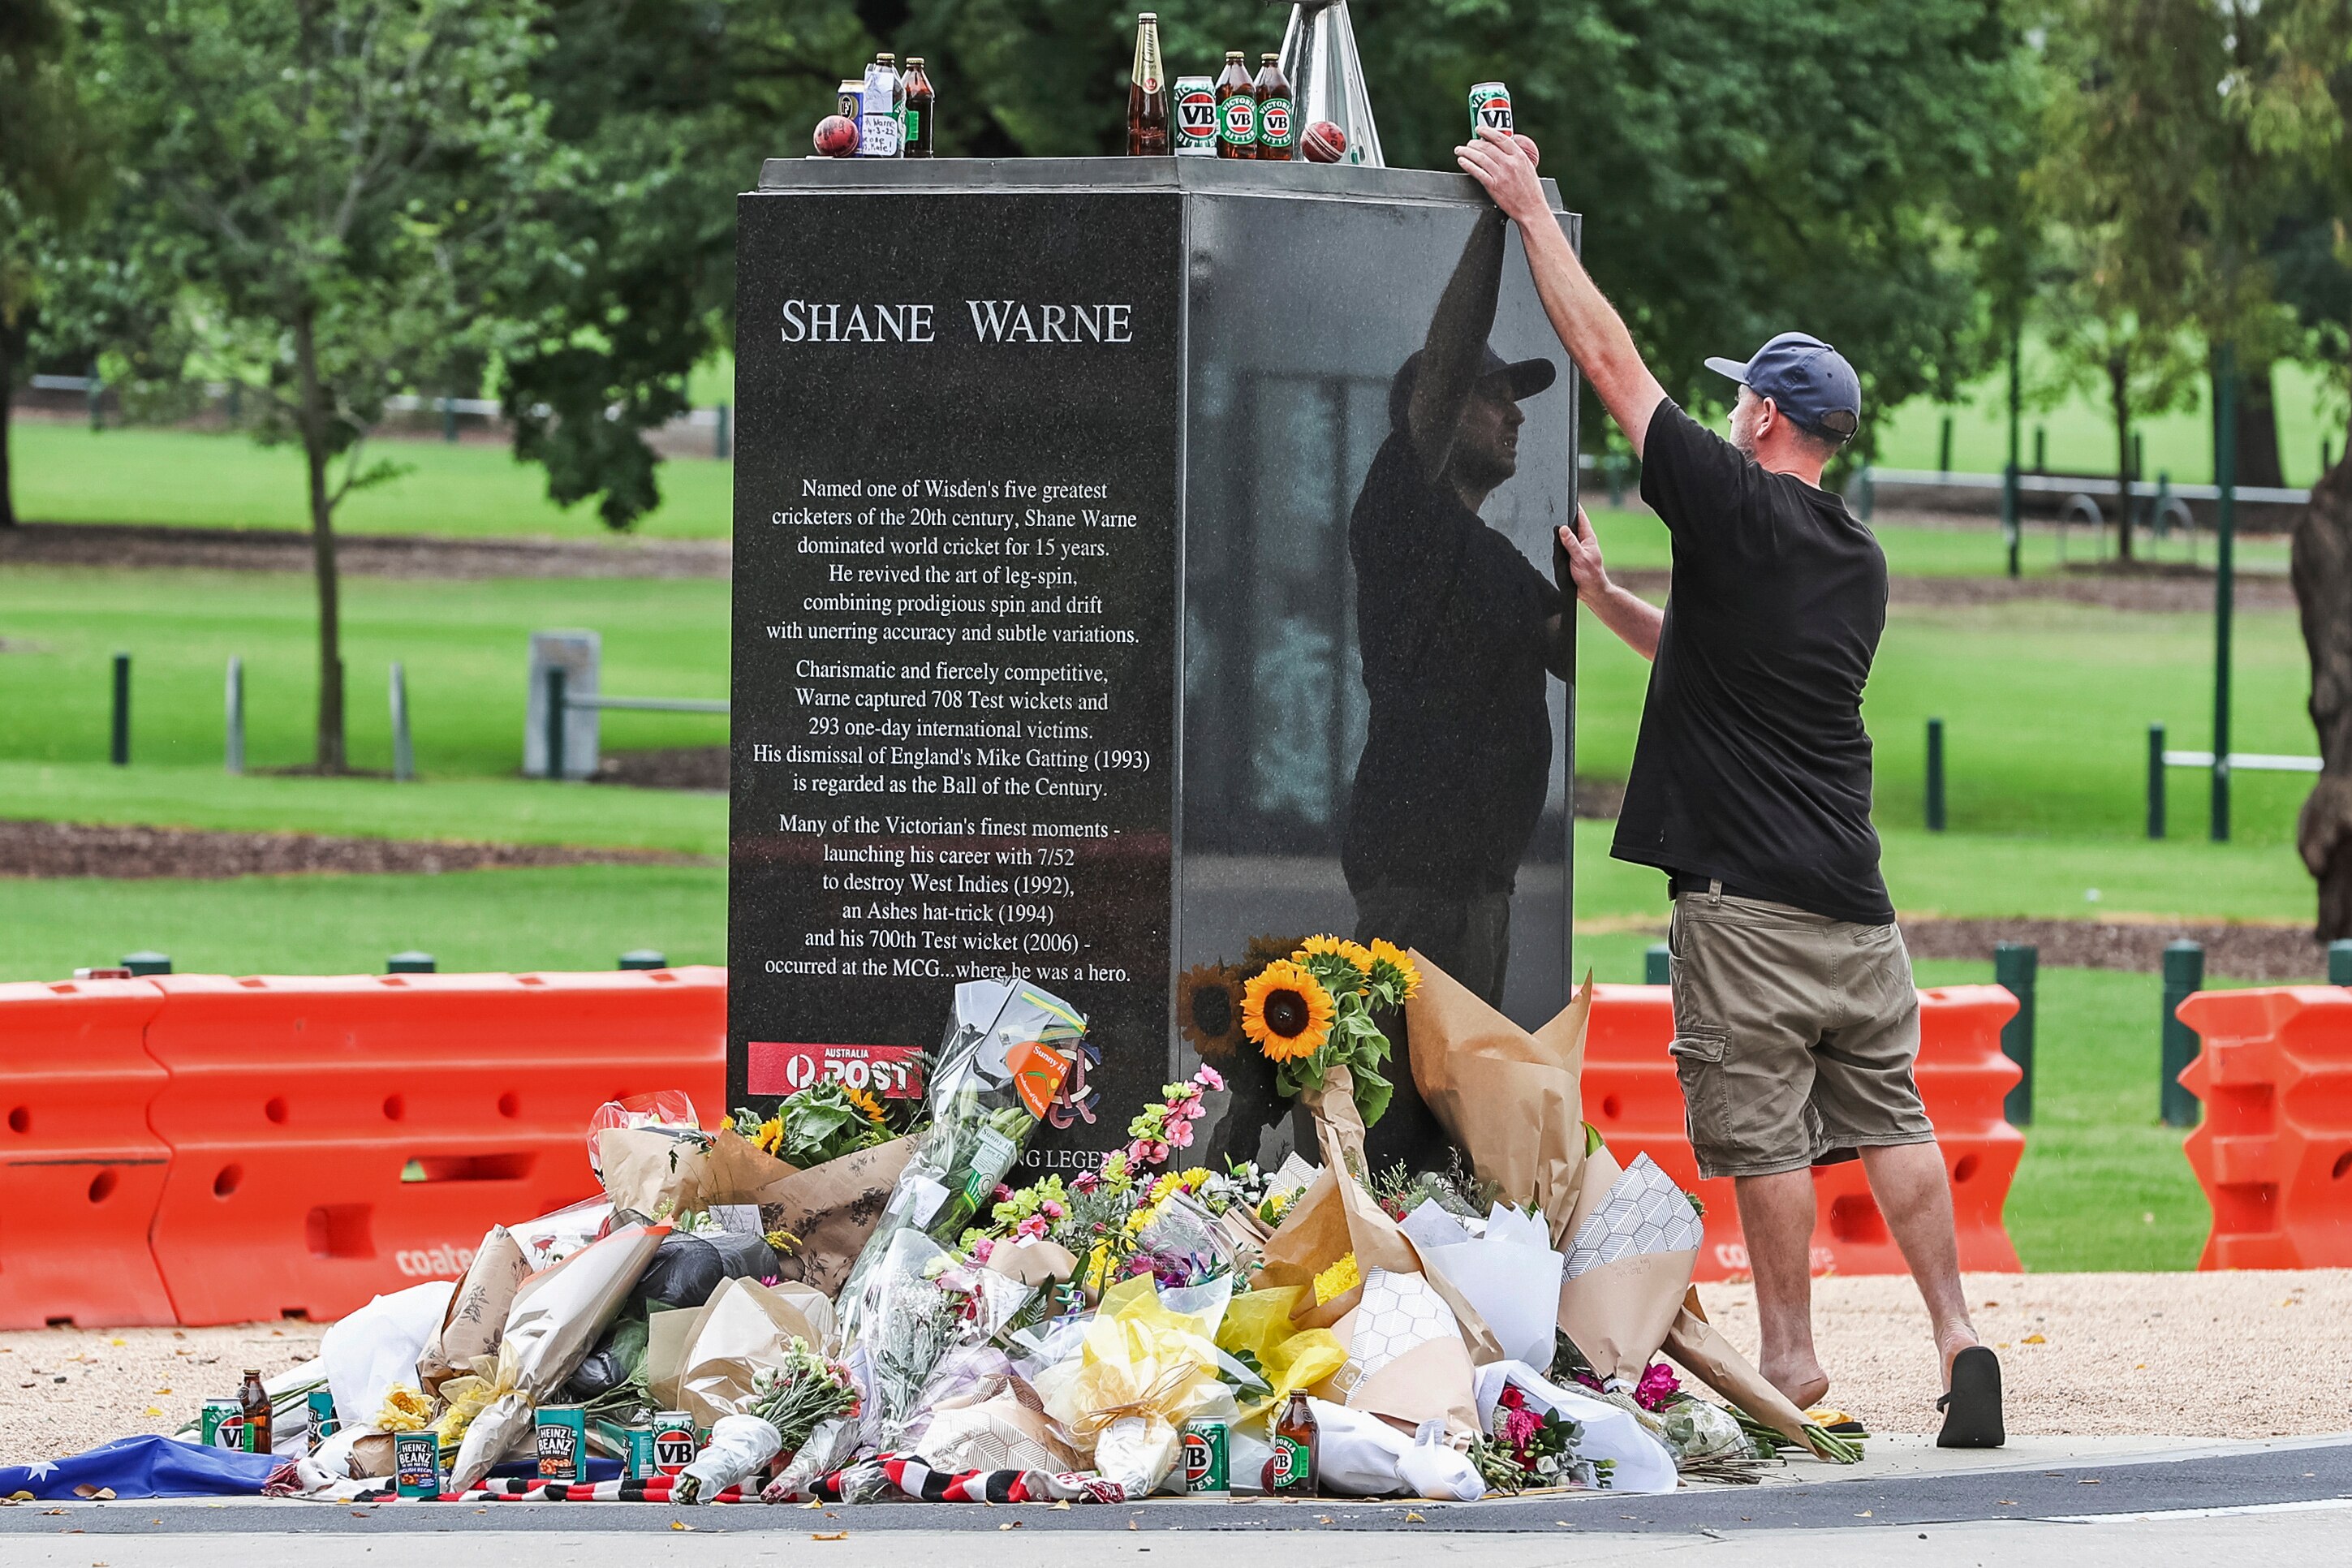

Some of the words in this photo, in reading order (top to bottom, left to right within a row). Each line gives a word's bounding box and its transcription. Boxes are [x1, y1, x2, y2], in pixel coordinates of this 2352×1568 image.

[1174, 84, 1216, 101] VICORI
[1222, 97, 1256, 112] VICTORIA
[1182, 106, 1215, 124] VB
[1230, 114, 1250, 125] VB
[1267, 117, 1287, 128] VB
[1480, 110, 1511, 128] VB
[1177, 132, 1217, 147] BITTE
[1225, 130, 1255, 141] BITTER
[781, 299, 936, 342] SHANE
[965, 299, 1133, 342] WARNE
[801, 478, 862, 498] Named
[867, 484, 897, 498] one
[902, 479, 921, 498] of
[924, 479, 999, 498] Wisden's
[1004, 479, 1037, 498] five
[1041, 483, 1108, 503] greatest
[772, 506, 852, 525] cricketers
[857, 506, 877, 526] of
[880, 507, 906, 526] the
[910, 507, 947, 526] 20th
[952, 511, 1019, 532] century,
[1024, 508, 1076, 528] Shane
[1080, 509, 1137, 528] Warne
[797, 536, 885, 554] dominated
[890, 536, 938, 554] world
[943, 536, 1000, 556] cricket
[1005, 536, 1031, 556] for
[1036, 538, 1055, 556] 15
[1060, 543, 1109, 561] years.
[829, 563, 854, 582] He
[857, 564, 920, 583] revived
[925, 565, 950, 584] the
[955, 568, 978, 584] art
[982, 565, 1002, 584] of
[1005, 566, 1078, 589] leg-spin,
[803, 592, 893, 616] combining
[897, 593, 986, 617] prodigious
[991, 594, 1026, 618] spin
[1031, 595, 1062, 614] and
[1066, 595, 1103, 614] drift
[766, 620, 803, 639] with
[808, 621, 878, 644] unerring
[882, 627, 957, 646] accuracy
[961, 623, 992, 641] and
[997, 623, 1047, 642] subtle
[1052, 624, 1139, 644] variations.
[795, 659, 896, 679] Charismatic
[900, 661, 931, 679] and
[935, 661, 1000, 685] fiercely
[1004, 663, 1108, 687] competitive,
[794, 687, 851, 707] Warne
[855, 689, 927, 712] captured
[931, 689, 963, 709] 708
[967, 690, 1005, 709] Test
[1009, 691, 1073, 710] wickets
[1078, 692, 1109, 711] and
[808, 717, 839, 735] 293
[844, 717, 911, 742] one-day
[916, 717, 1022, 738] international
[1027, 720, 1093, 739] victims.
[753, 743, 782, 763] His
[786, 744, 863, 764] dismissal
[868, 746, 888, 765] of
[890, 746, 971, 770] England's
[976, 747, 1021, 767] Mike
[1026, 748, 1089, 773] Gatting
[1094, 749, 1150, 773] (1993)
[793, 773, 808, 791] is
[811, 773, 885, 797] regarded
[889, 779, 907, 793] as
[911, 775, 937, 794] the
[941, 775, 977, 794] Ball
[981, 776, 1002, 795] of
[1004, 777, 1031, 795] the
[1035, 778, 1108, 802] Century.
[779, 813, 827, 838] Many
[832, 815, 851, 833] of
[854, 815, 881, 834] the
[885, 816, 976, 835] Victorian's
[980, 816, 1027, 836] finest
[1032, 822, 1109, 838] moments
[823, 843, 906, 868] launching
[910, 845, 934, 864] his
[939, 850, 991, 864] career
[995, 846, 1032, 865] with
[1037, 847, 1075, 866] 7/52
[822, 874, 839, 890] to
[843, 872, 905, 896] destroy
[909, 872, 953, 892] West
[957, 874, 1009, 894] Indies
[1014, 876, 1075, 898] (1992),
[842, 905, 862, 919] an
[867, 901, 918, 920] Ashes
[922, 902, 993, 922] hat-trick
[998, 903, 1053, 927] (1994)
[804, 928, 835, 946] and
[839, 928, 864, 947] his
[868, 929, 916, 949] 700th
[921, 930, 958, 950] Test
[962, 932, 1019, 950] wicket
[1023, 933, 1079, 955] (2006)
[765, 957, 838, 975] occurred
[842, 960, 857, 976] at
[862, 958, 888, 976] the
[1011, 962, 1032, 980] he
[1036, 967, 1069, 980] was
[1074, 967, 1083, 981] a
[1088, 963, 1131, 982] hero.
[825, 1048, 869, 1058] AUSTRALIA
[1033, 1045, 1058, 1068] Sunny
[824, 1059, 913, 1091] POST
[981, 1128, 1003, 1147] Sunny
[394, 1243, 476, 1277] coate
[538, 1438, 573, 1452] BEANZ
[541, 1428, 567, 1438] HEINZ
[1186, 1423, 1217, 1445] ORIA
[398, 1452, 432, 1464] BEANZ
[402, 1443, 427, 1453] HEINZ
[657, 1443, 692, 1463] VB
[1276, 1438, 1296, 1454] TORIA
[1187, 1475, 1216, 1492] TER
[1275, 1473, 1294, 1484] TTER
